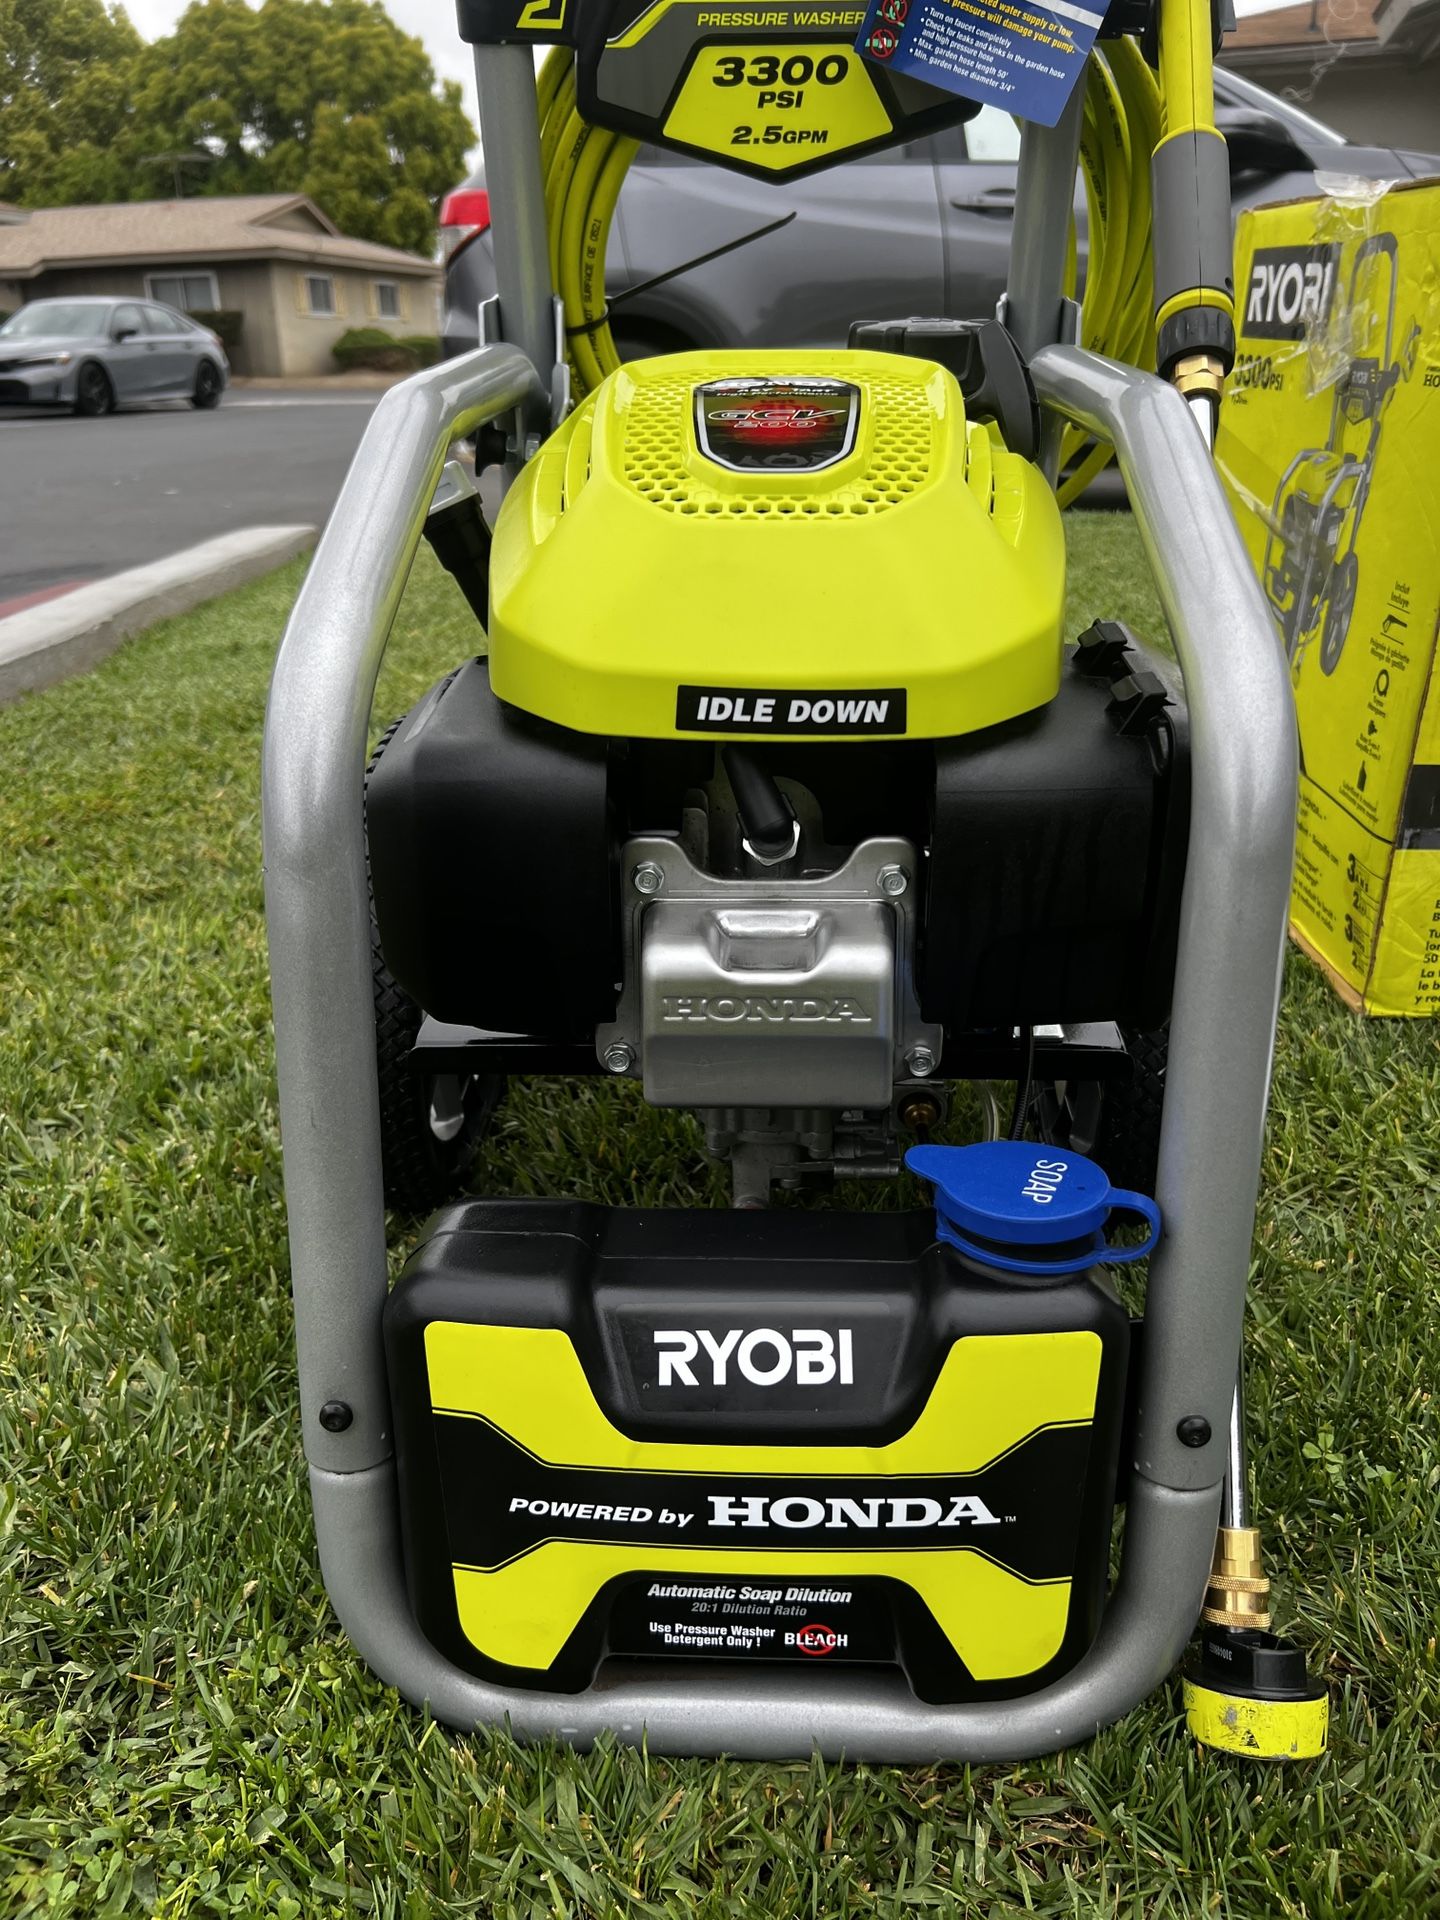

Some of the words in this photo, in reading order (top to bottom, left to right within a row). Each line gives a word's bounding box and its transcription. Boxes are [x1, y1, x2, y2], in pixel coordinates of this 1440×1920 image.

[697, 12, 788, 26] PRESSURE
[794, 11, 866, 25] WASHER
[930, 7, 945, 19] Turn
[945, 16, 954, 24] on
[954, 17, 976, 32] faucet
[975, 28, 1012, 48] completely
[952, 1, 986, 18] pressure
[987, 12, 1003, 25] will
[1003, 19, 1034, 37] damage
[1033, 31, 1052, 43] your
[1051, 39, 1075, 54] pump.
[999, 4, 1022, 18] water
[1022, 12, 1048, 29] supply
[1048, 23, 1057, 32] or
[1058, 25, 1074, 38] low
[922, 28, 935, 39] and
[935, 33, 950, 45] high
[949, 40, 978, 57] pressure
[978, 51, 994, 62] hose
[925, 18, 946, 33] Check
[946, 27, 956, 37] for
[956, 31, 974, 44] leaks
[975, 39, 988, 50] and
[988, 44, 1006, 57] kinks
[1007, 51, 1014, 60] in
[1014, 54, 1025, 64] the
[1025, 60, 1049, 74] garden
[1049, 69, 1065, 79] hose
[917, 38, 933, 51] Max.
[934, 46, 958, 60] garden
[959, 55, 974, 67] hose
[975, 61, 997, 76] length
[712, 54, 849, 87] 3300
[914, 49, 928, 61] Min.
[928, 56, 952, 71] garden
[952, 65, 969, 76] hose
[969, 72, 999, 87] diameter
[757, 90, 804, 109] PSI
[731, 125, 828, 144] 2.5GPM
[1247, 262, 1333, 324] RYOBI
[1424, 374, 1440, 388] HO
[708, 409, 847, 420] GCV
[696, 697, 775, 722] IDLE
[787, 698, 889, 723] DOWN
[1429, 929, 1440, 939] Tu
[1423, 954, 1438, 963] 50
[1421, 969, 1434, 978] La
[1418, 981, 1429, 990] le
[662, 996, 872, 1022] HONDA
[1415, 996, 1422, 1005] y
[1021, 1160, 1068, 1203] SOAP
[653, 1329, 854, 1386] RYOBI
[508, 1498, 653, 1522] POWERED
[658, 1509, 695, 1527] by
[707, 1495, 1001, 1528] HONDA
[647, 1584, 736, 1600] Automatic
[739, 1587, 783, 1603] Soap
[784, 1588, 853, 1603] Dilution
[691, 1602, 717, 1613] 20:1
[721, 1603, 771, 1615] Dilution
[774, 1605, 808, 1616] Ratio
[649, 1622, 672, 1633] Use
[675, 1623, 728, 1636] Pressure
[730, 1625, 776, 1637] Washer
[664, 1634, 724, 1647] Detergent
[726, 1636, 753, 1648] Only
[756, 1637, 761, 1647] !
[784, 1632, 848, 1647] BLEACH
